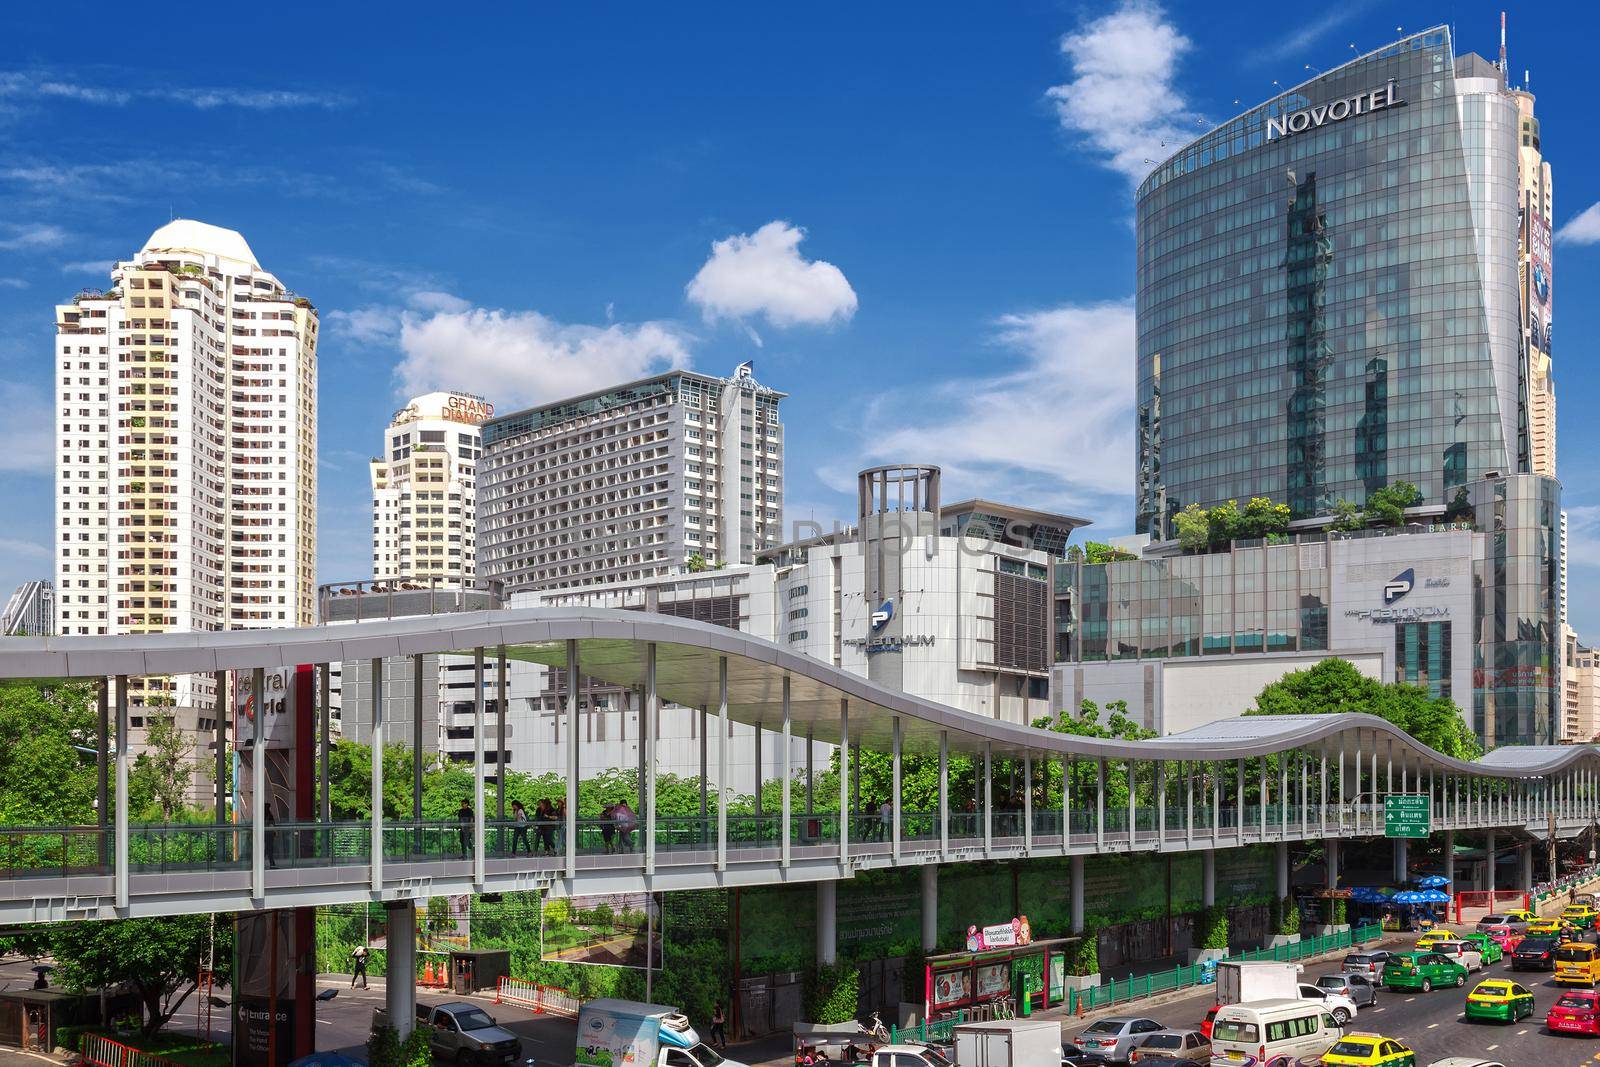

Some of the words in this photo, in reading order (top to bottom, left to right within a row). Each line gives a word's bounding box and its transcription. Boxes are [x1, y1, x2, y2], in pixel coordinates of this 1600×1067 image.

[1267, 78, 1404, 140] NOVOTEL
[448, 396, 495, 415] GRAND
[239, 669, 288, 691] ceral
[249, 1010, 288, 1021] Entrace
